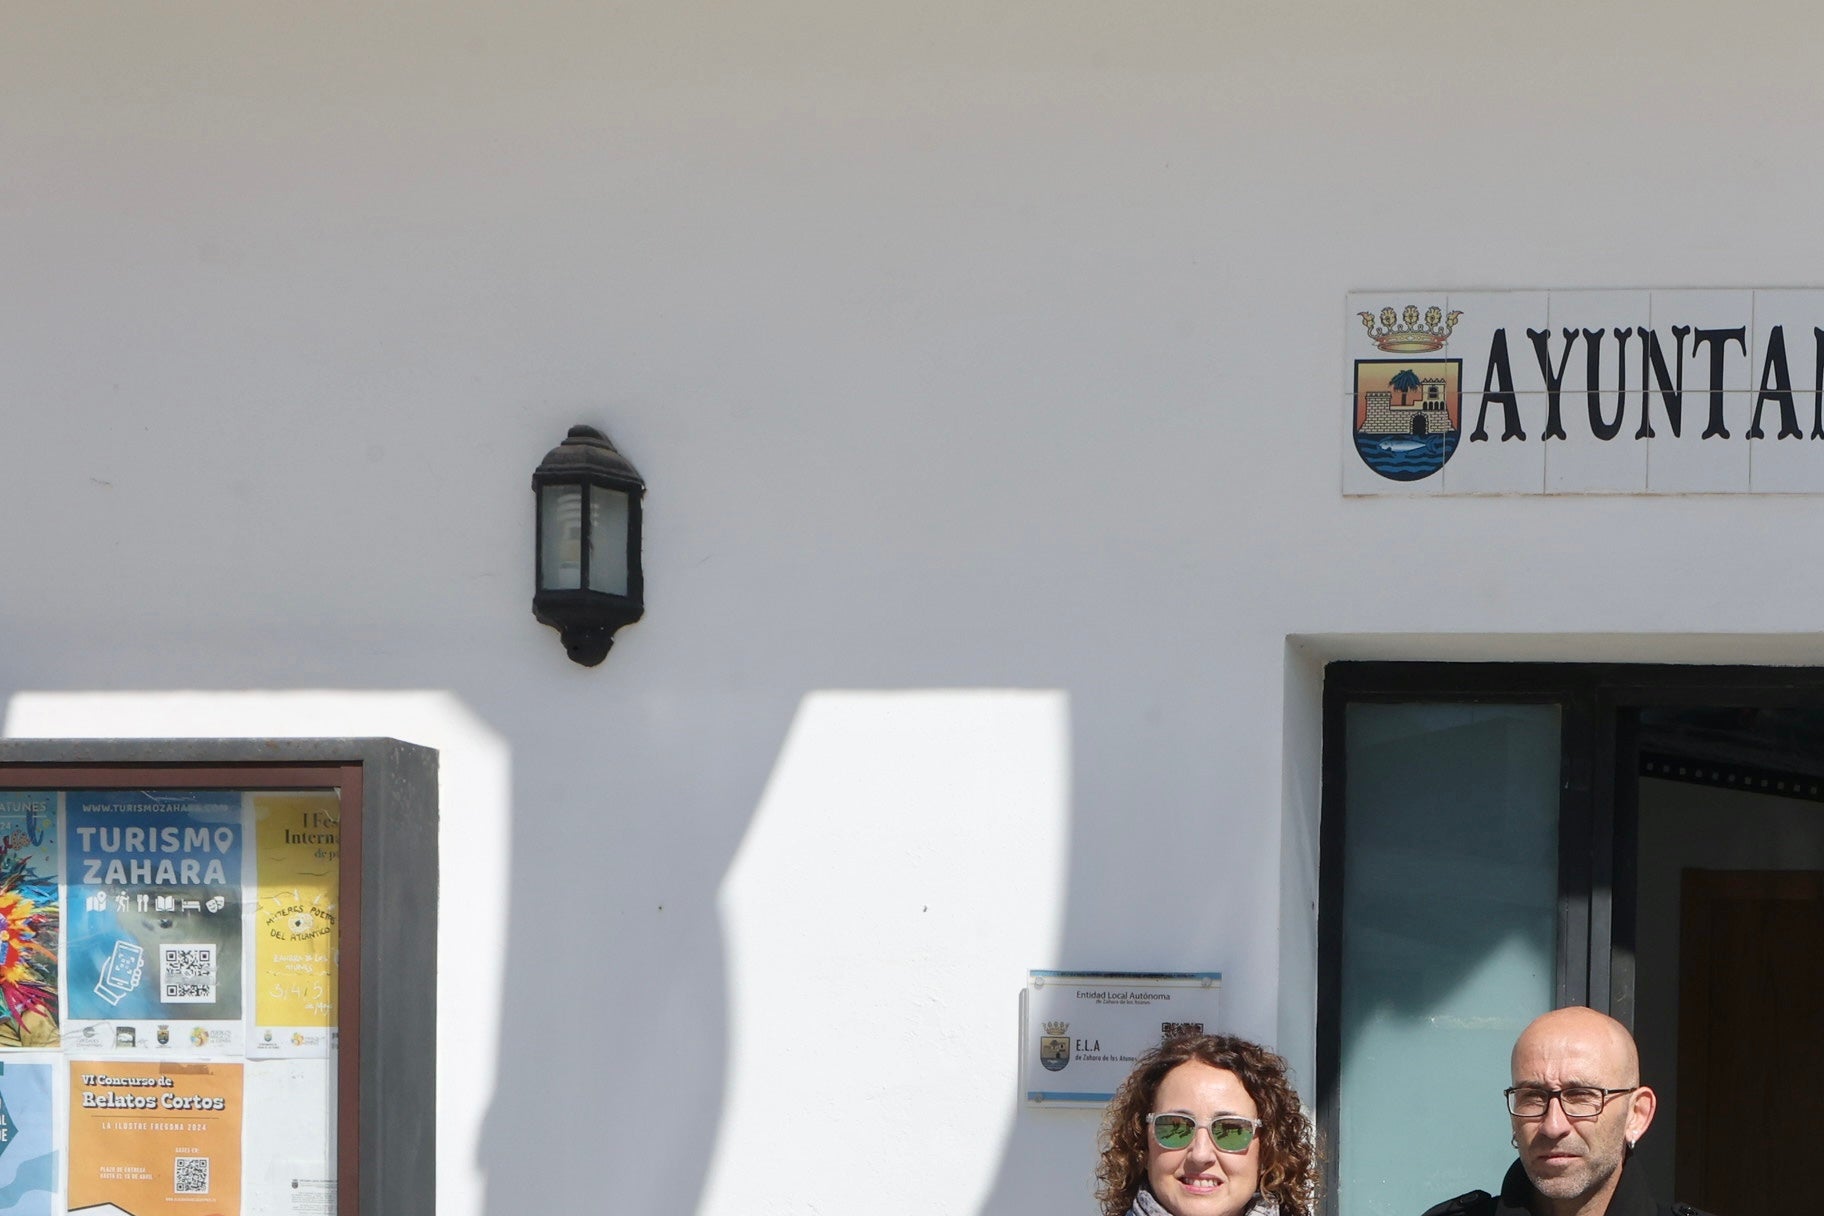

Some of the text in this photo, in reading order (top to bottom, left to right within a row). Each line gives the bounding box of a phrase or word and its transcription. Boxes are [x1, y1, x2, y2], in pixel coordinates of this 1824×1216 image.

[285, 829, 340, 845] Intern
[83, 858, 227, 885] ZAHARA
[1076, 991, 1171, 1001] Entidad Local Autónoma
[1076, 1039, 1100, 1052] E.L.A
[82, 1074, 174, 1088] VI Concurso de
[82, 1091, 226, 1112] Relatos Cortos
[188, 1123, 208, 1132] 2024
